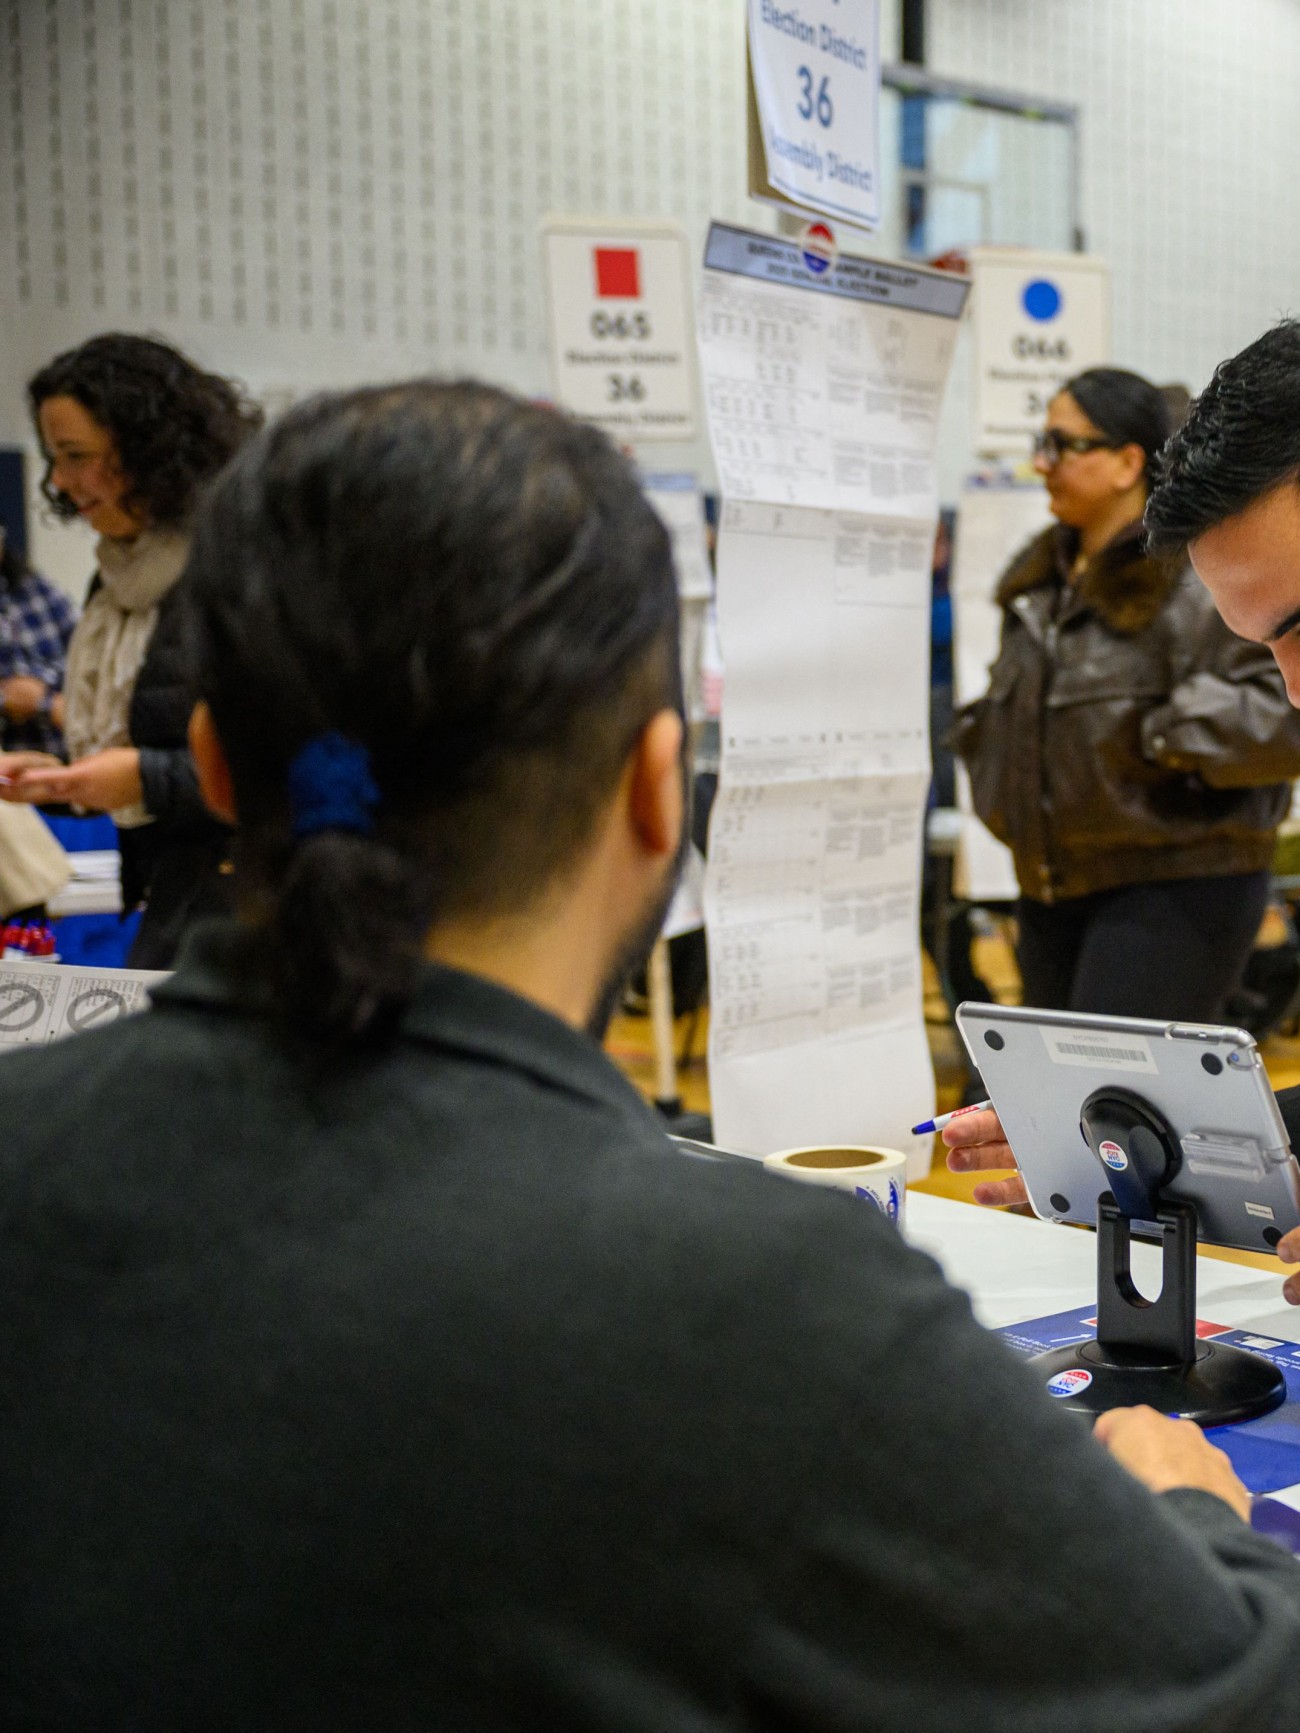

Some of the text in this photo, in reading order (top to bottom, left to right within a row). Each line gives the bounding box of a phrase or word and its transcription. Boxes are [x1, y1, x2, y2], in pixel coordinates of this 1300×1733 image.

[761, 0, 867, 71] Election District
[797, 64, 834, 128] 36
[826, 150, 873, 193] District
[590, 311, 651, 340] 065
[607, 373, 647, 403] 36
